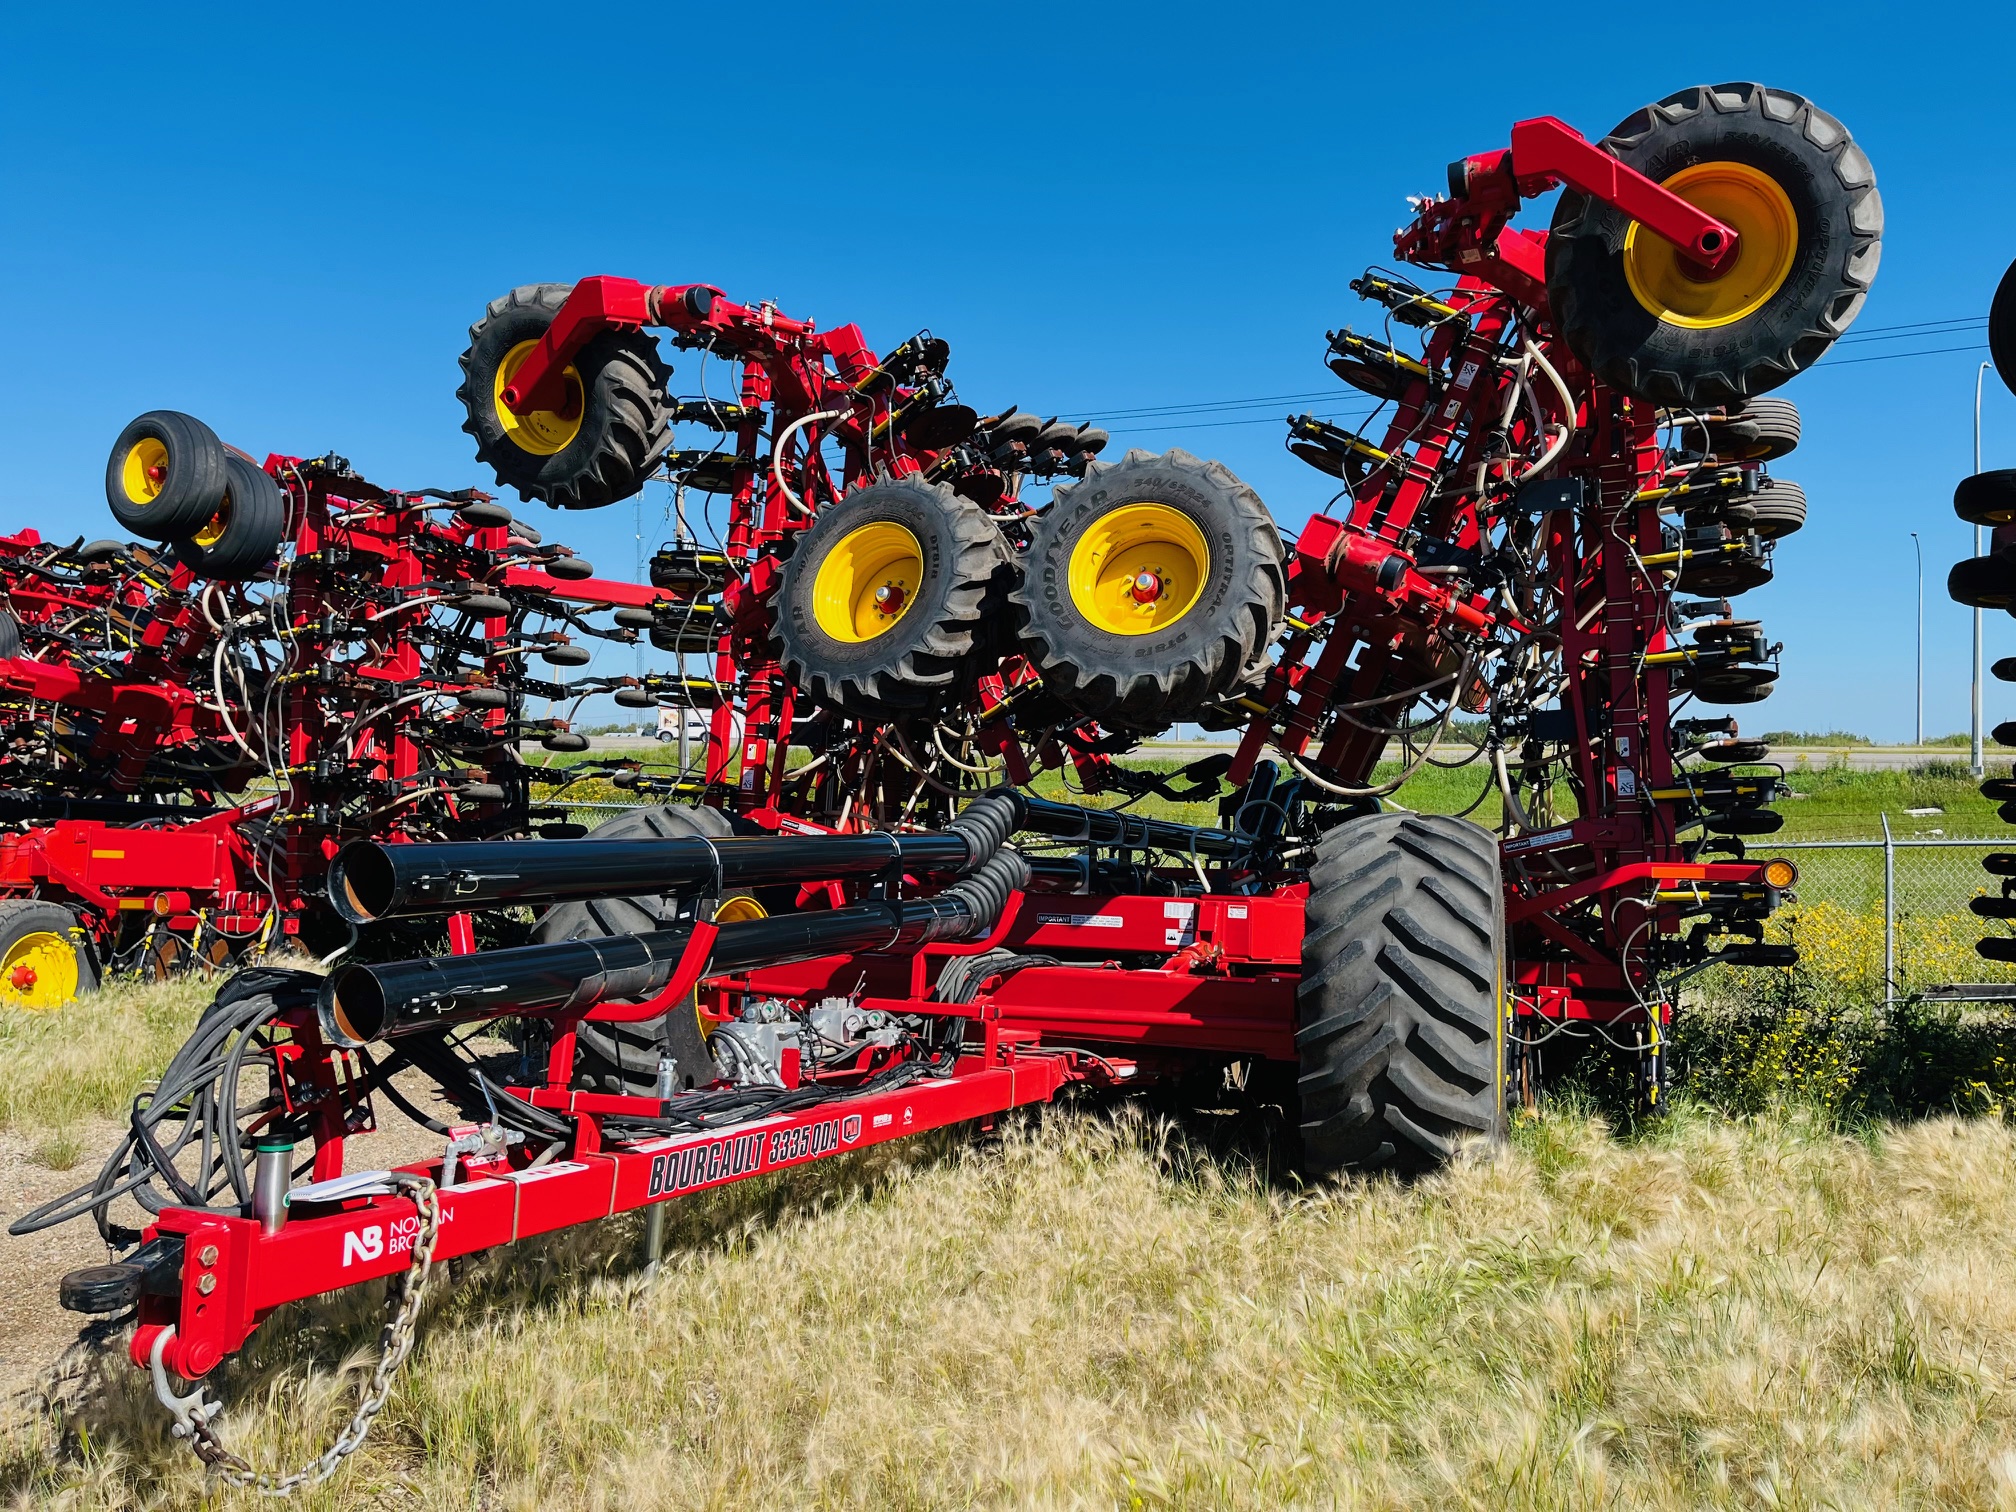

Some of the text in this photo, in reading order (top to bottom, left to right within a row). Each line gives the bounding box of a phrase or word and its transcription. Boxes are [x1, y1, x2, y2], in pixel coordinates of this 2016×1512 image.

[1042, 488, 1108, 631] GOODYEAR
[1206, 531, 1235, 618] OPTITRAC
[1038, 915, 1070, 923] IMPORTANT
[648, 1131, 766, 1198] BOURGAULT
[342, 1225, 384, 1268] NB
